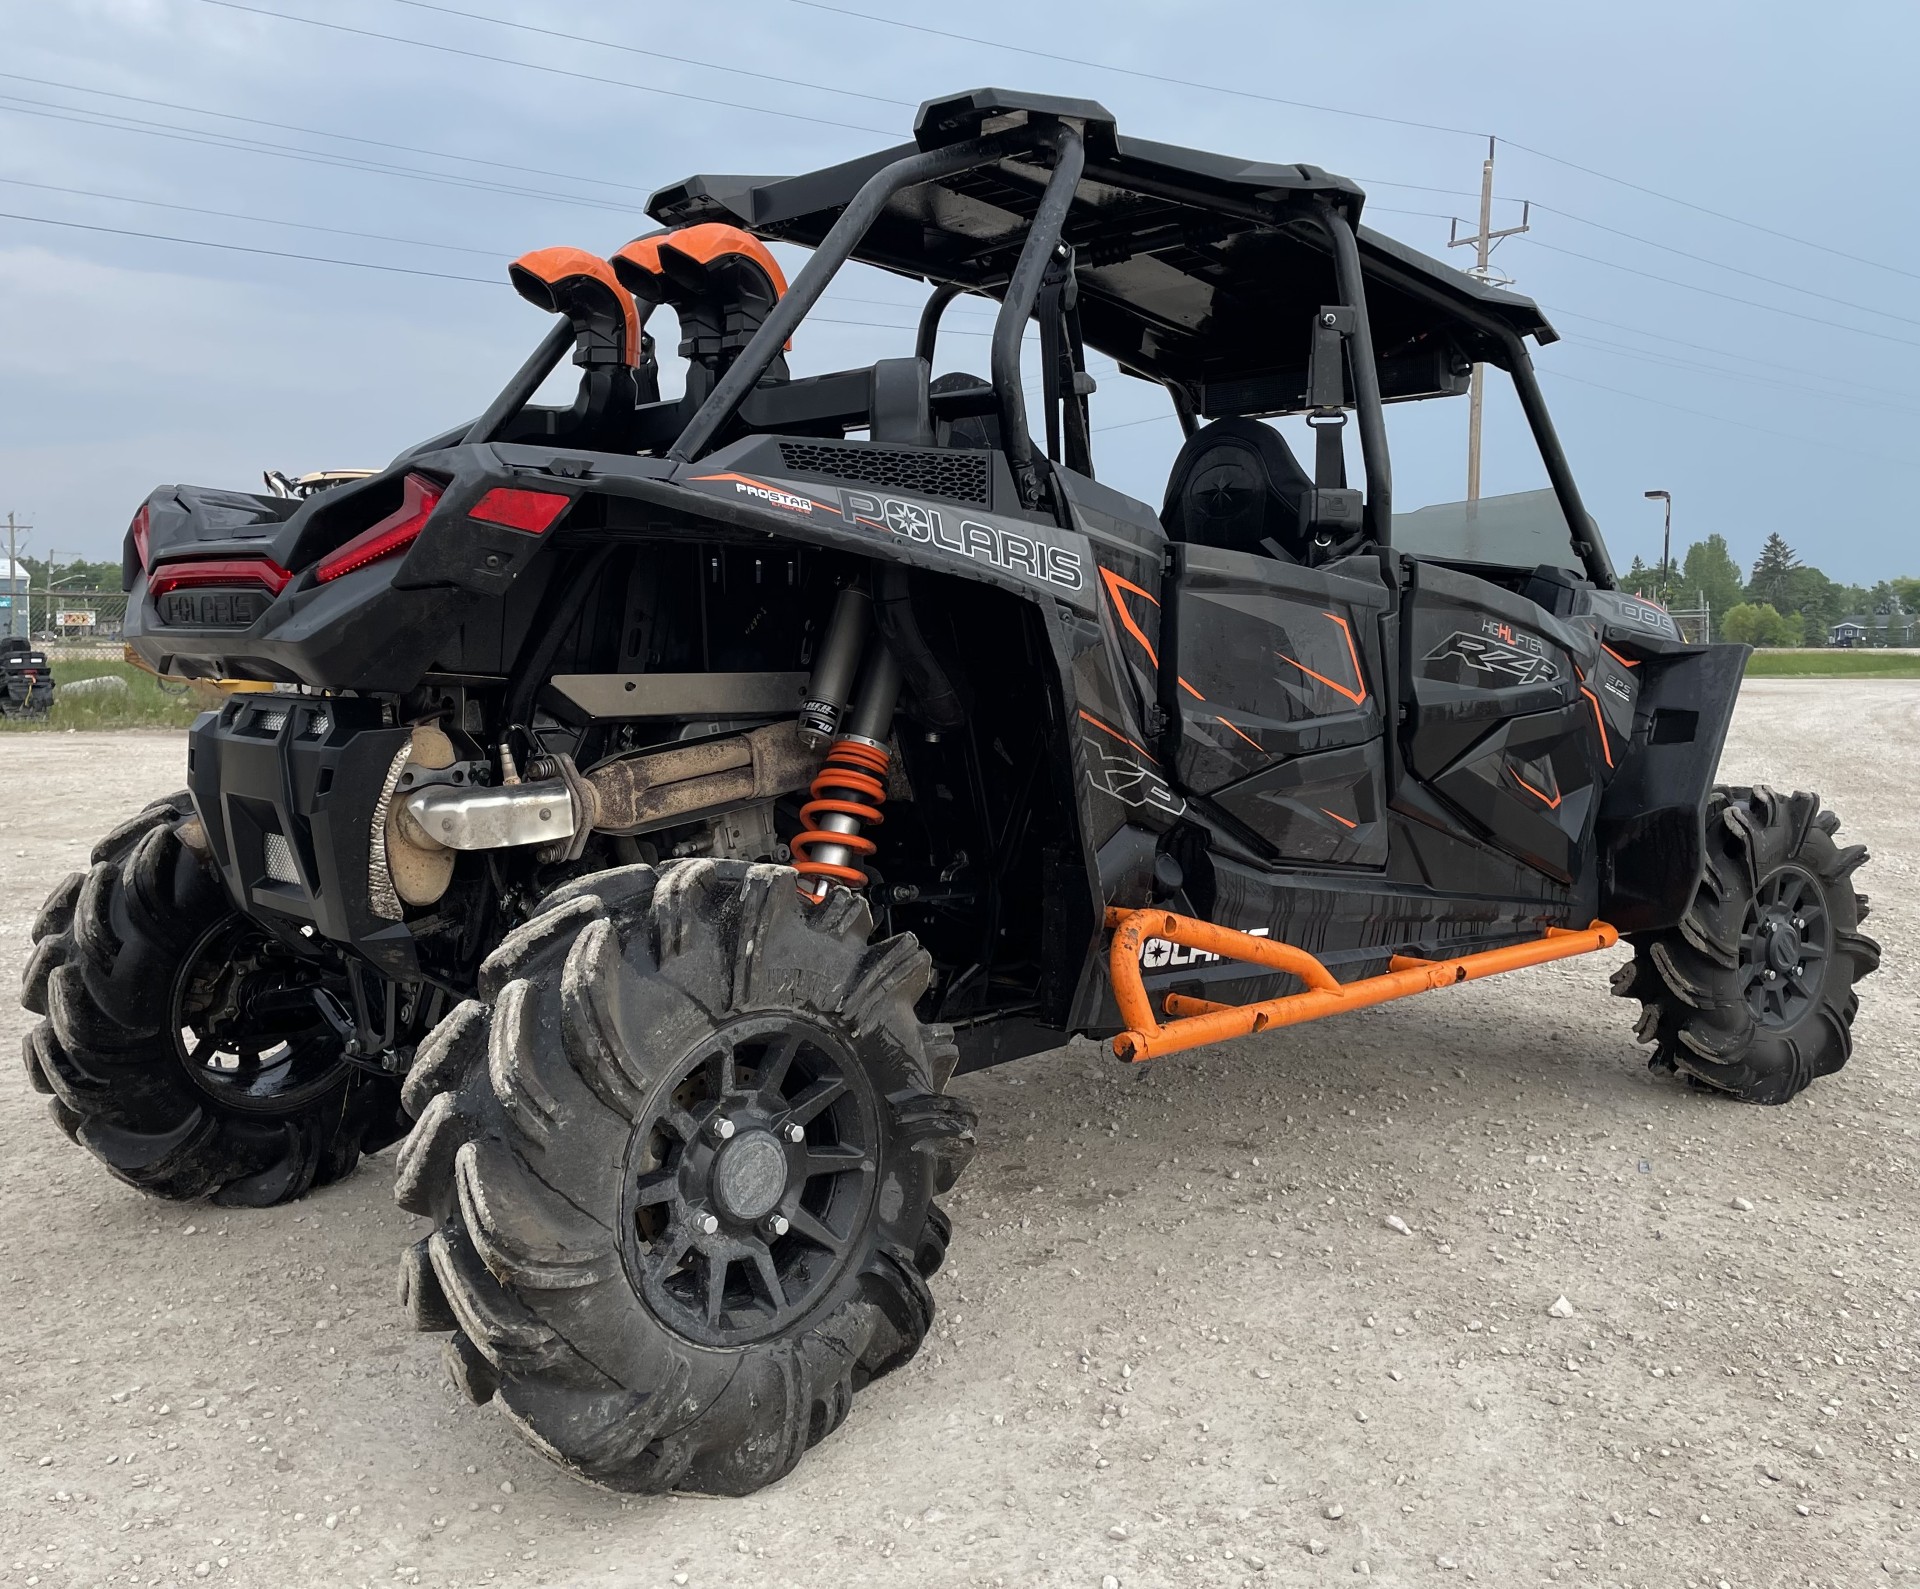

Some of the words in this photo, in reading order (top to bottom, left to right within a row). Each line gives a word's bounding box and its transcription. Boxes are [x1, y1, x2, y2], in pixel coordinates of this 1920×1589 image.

[736, 483, 812, 511] PROSTAR
[837, 487, 1083, 591] POLARIS
[1607, 674, 1631, 695] EPS
